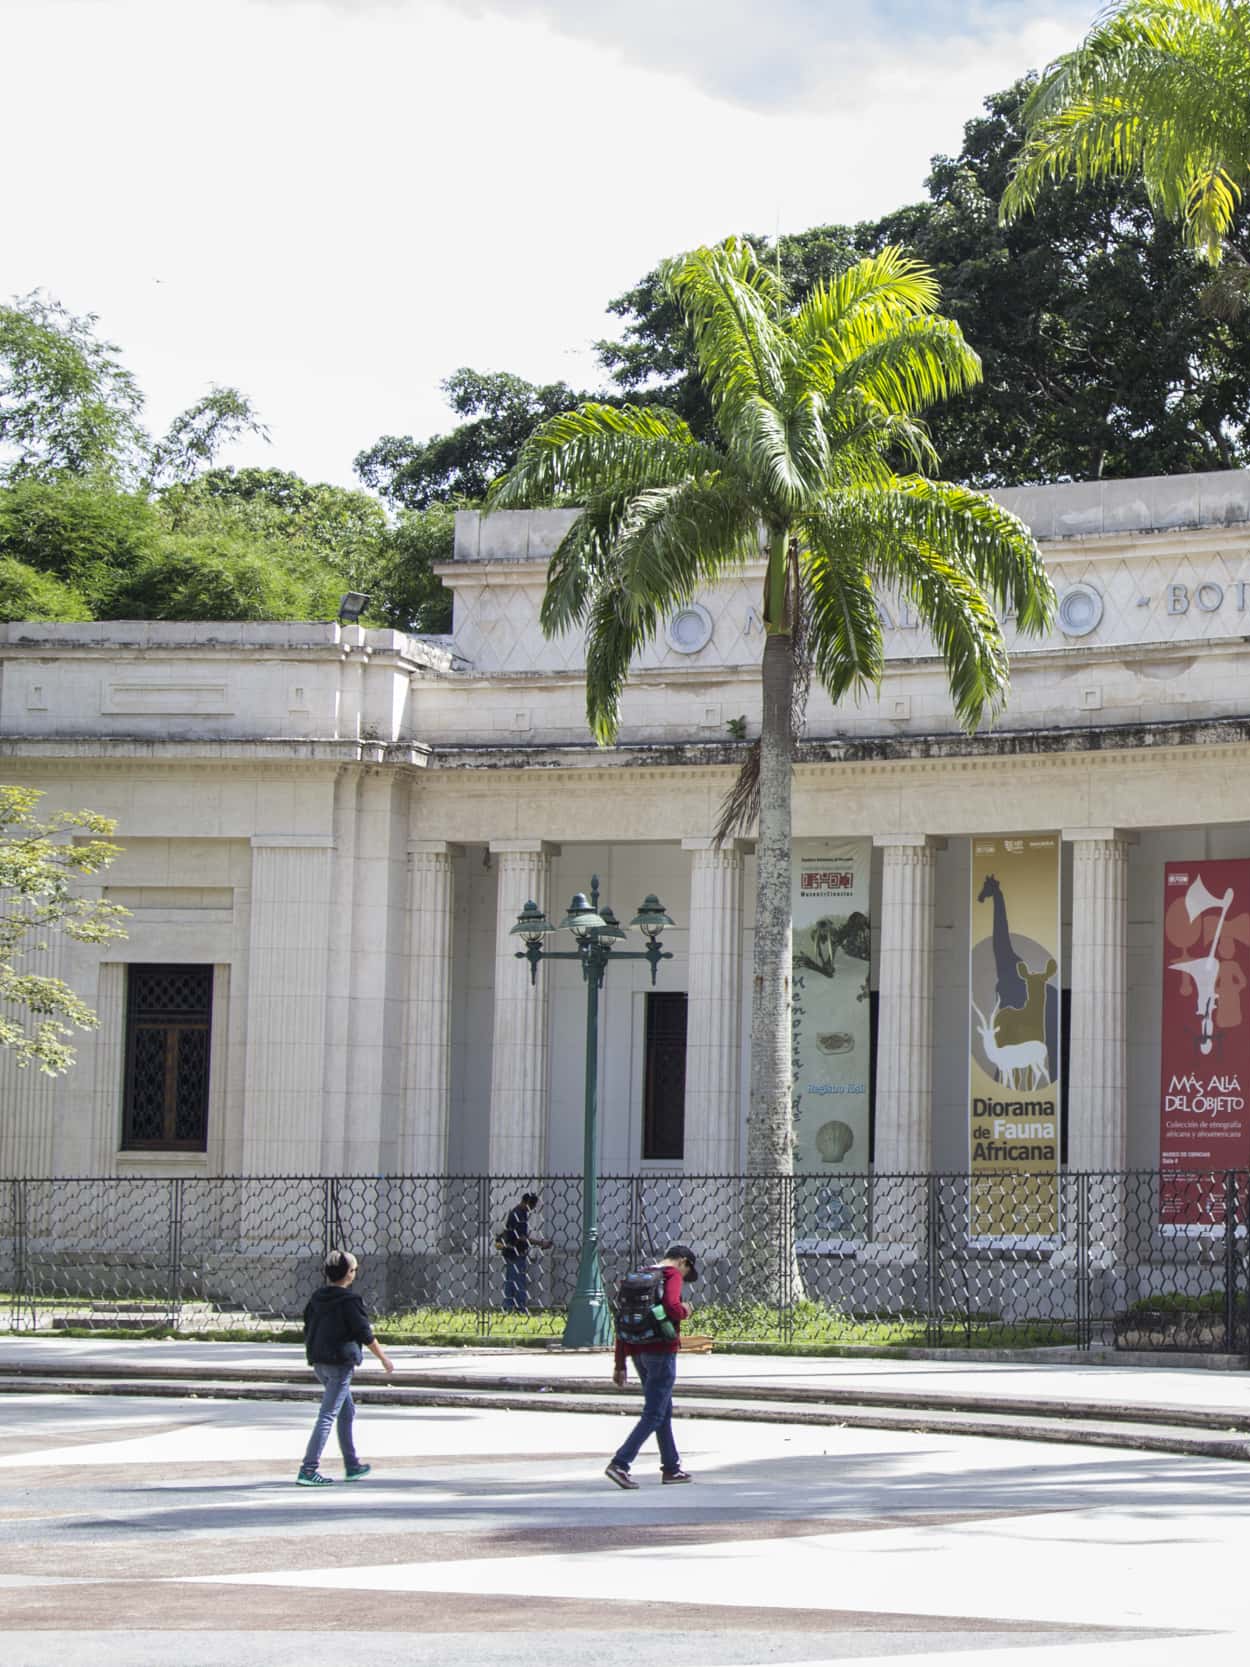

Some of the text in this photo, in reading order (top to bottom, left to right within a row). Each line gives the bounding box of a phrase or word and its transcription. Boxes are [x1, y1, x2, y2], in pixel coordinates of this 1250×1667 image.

[1169, 1072, 1241, 1096] MÁS ALLÁ
[973, 1097, 1055, 1117] Diorama
[1192, 1096, 1245, 1118] OBJETO
[973, 1120, 1055, 1139] de Fauna
[973, 1141, 1055, 1160] Africana
